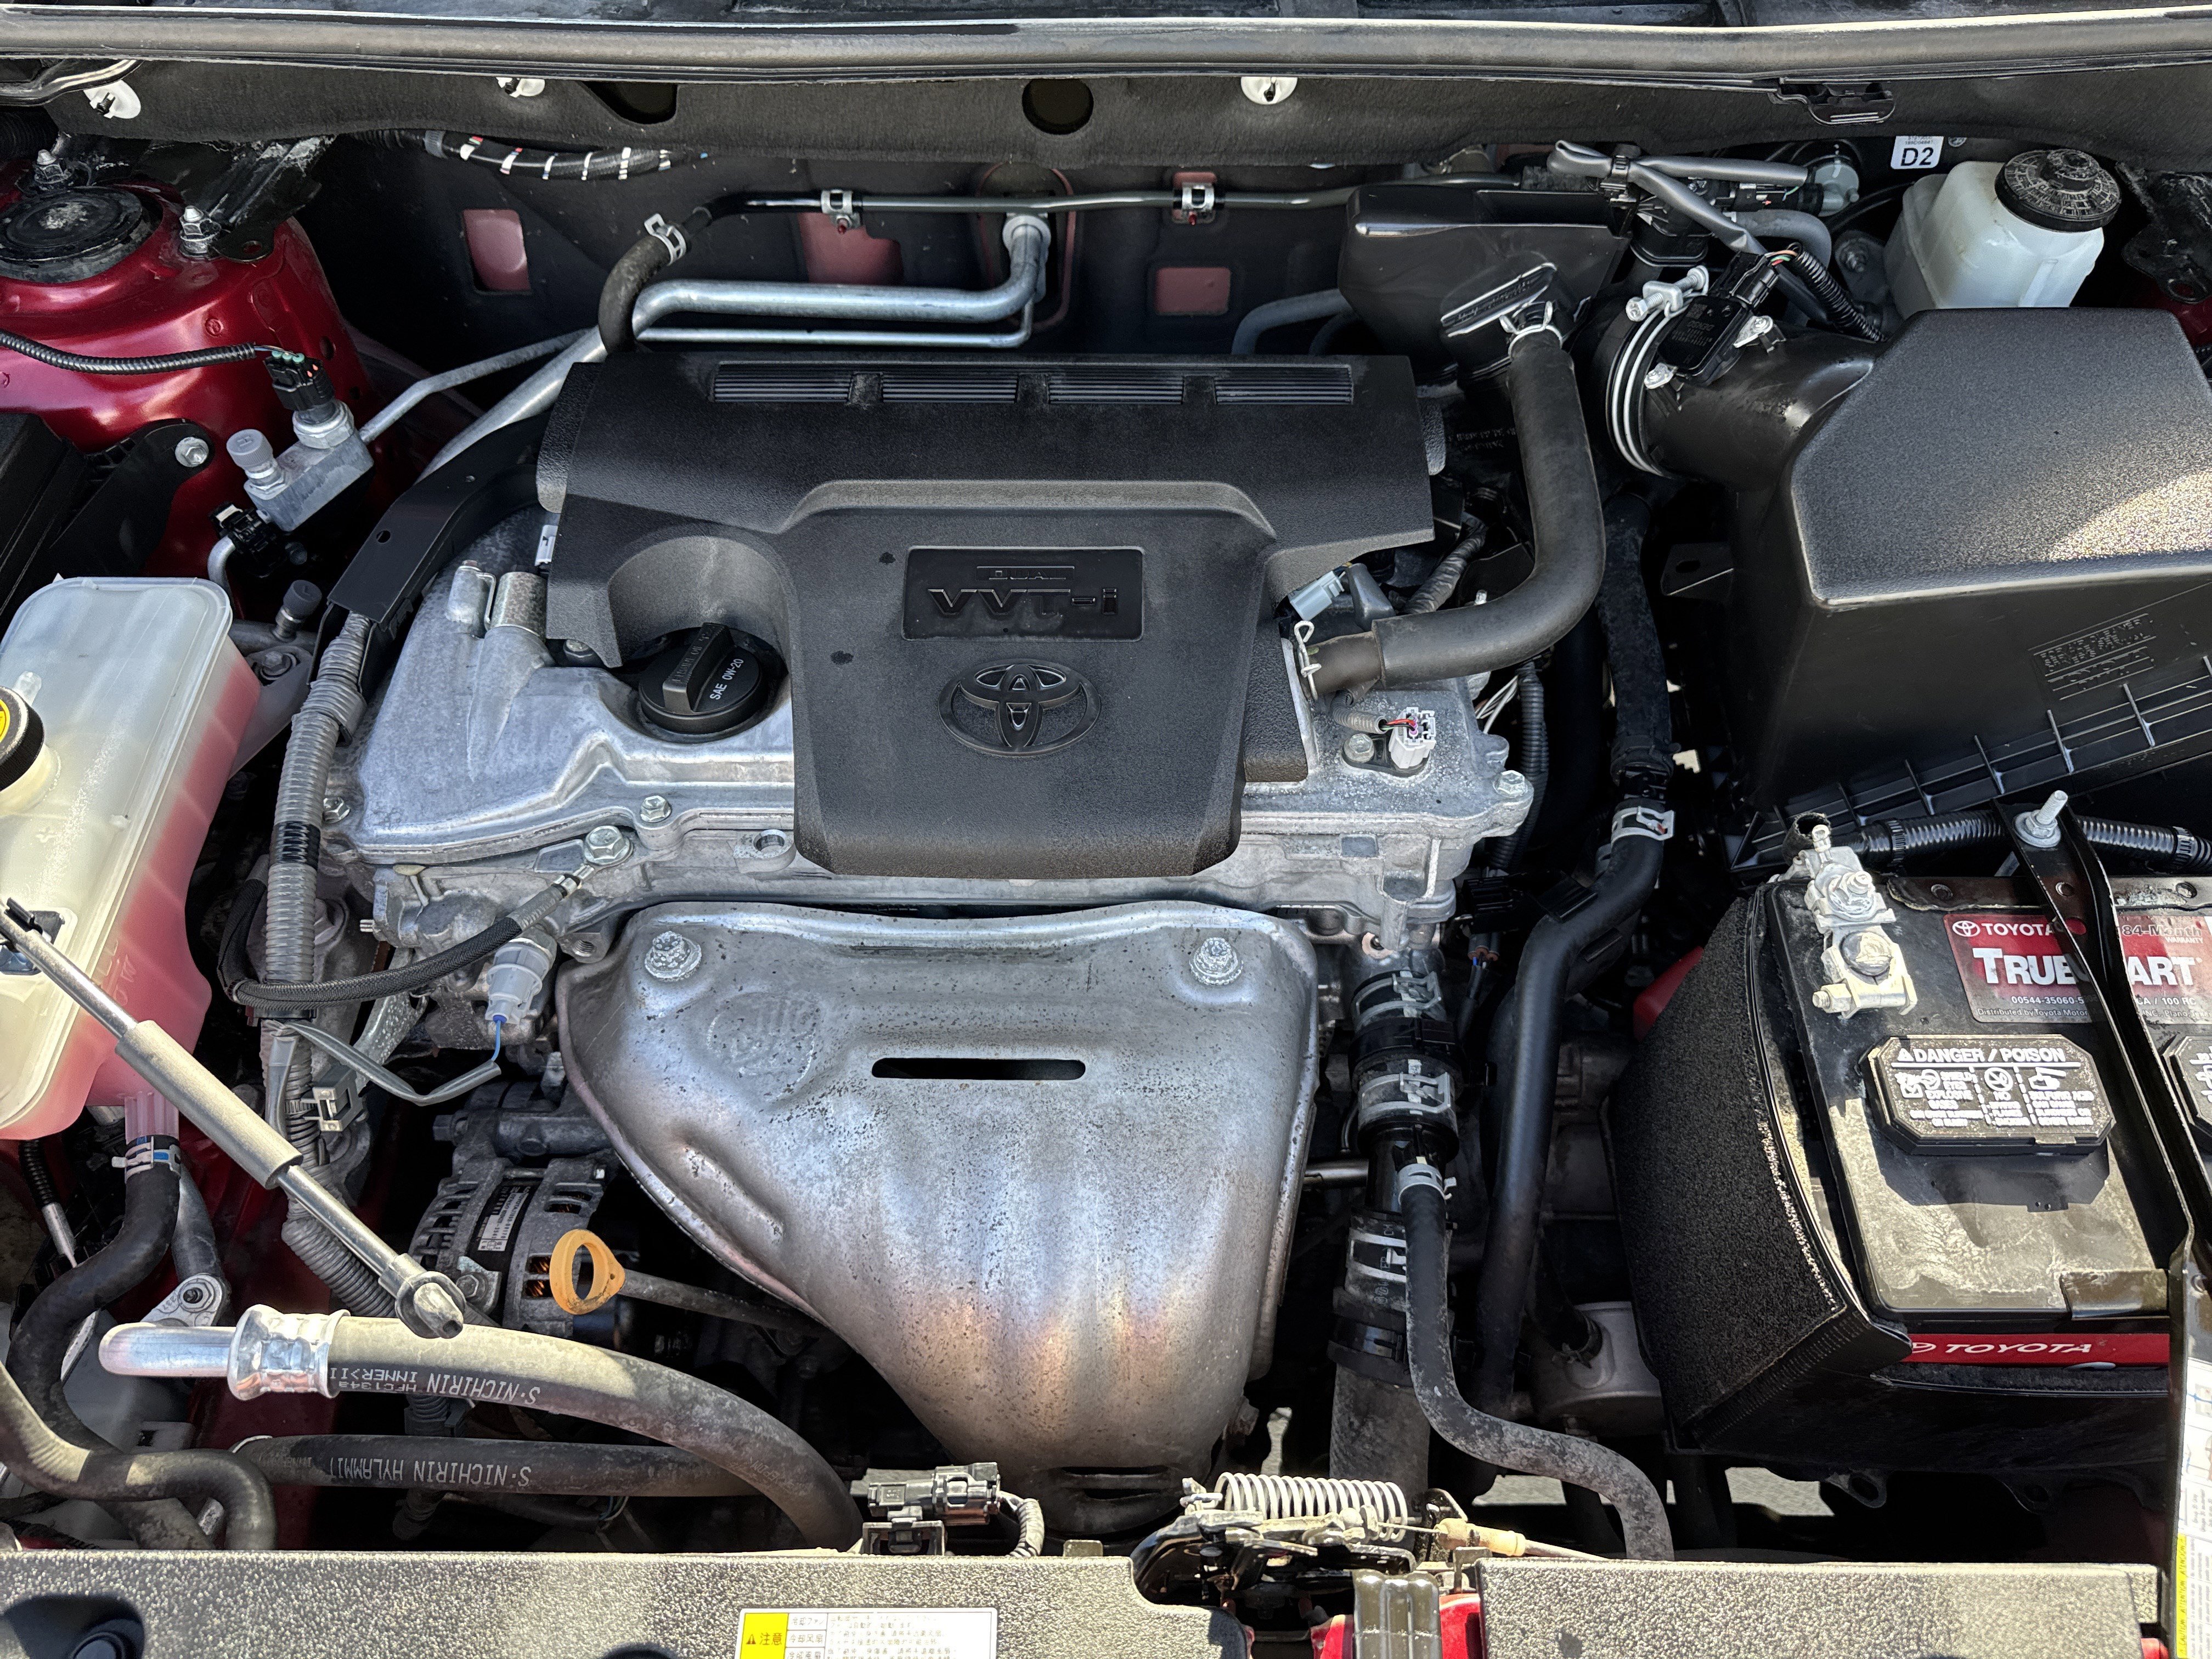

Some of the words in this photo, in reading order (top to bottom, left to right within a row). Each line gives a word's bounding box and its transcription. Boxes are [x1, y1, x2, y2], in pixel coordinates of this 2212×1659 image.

[1900, 147, 1934, 166] D2
[927, 588, 1118, 616] VVT-i
[709, 683, 727, 700] SAE
[721, 658, 744, 680] 0W-20
[1981, 923, 2055, 936] TOYOTA
[2162, 996, 2180, 1005] 100
[2023, 1009, 2034, 1018] by
[2034, 1009, 2062, 1018] Toyota
[1912, 1047, 1985, 1063] DANGER
[1999, 1047, 2066, 1063] POISON
[1993, 1091, 2011, 1101] NO
[1945, 1342, 2092, 1353] TOYOTA
[337, 1380, 417, 1392] HFC134a
[759, 1632, 783, 1646] 注意
